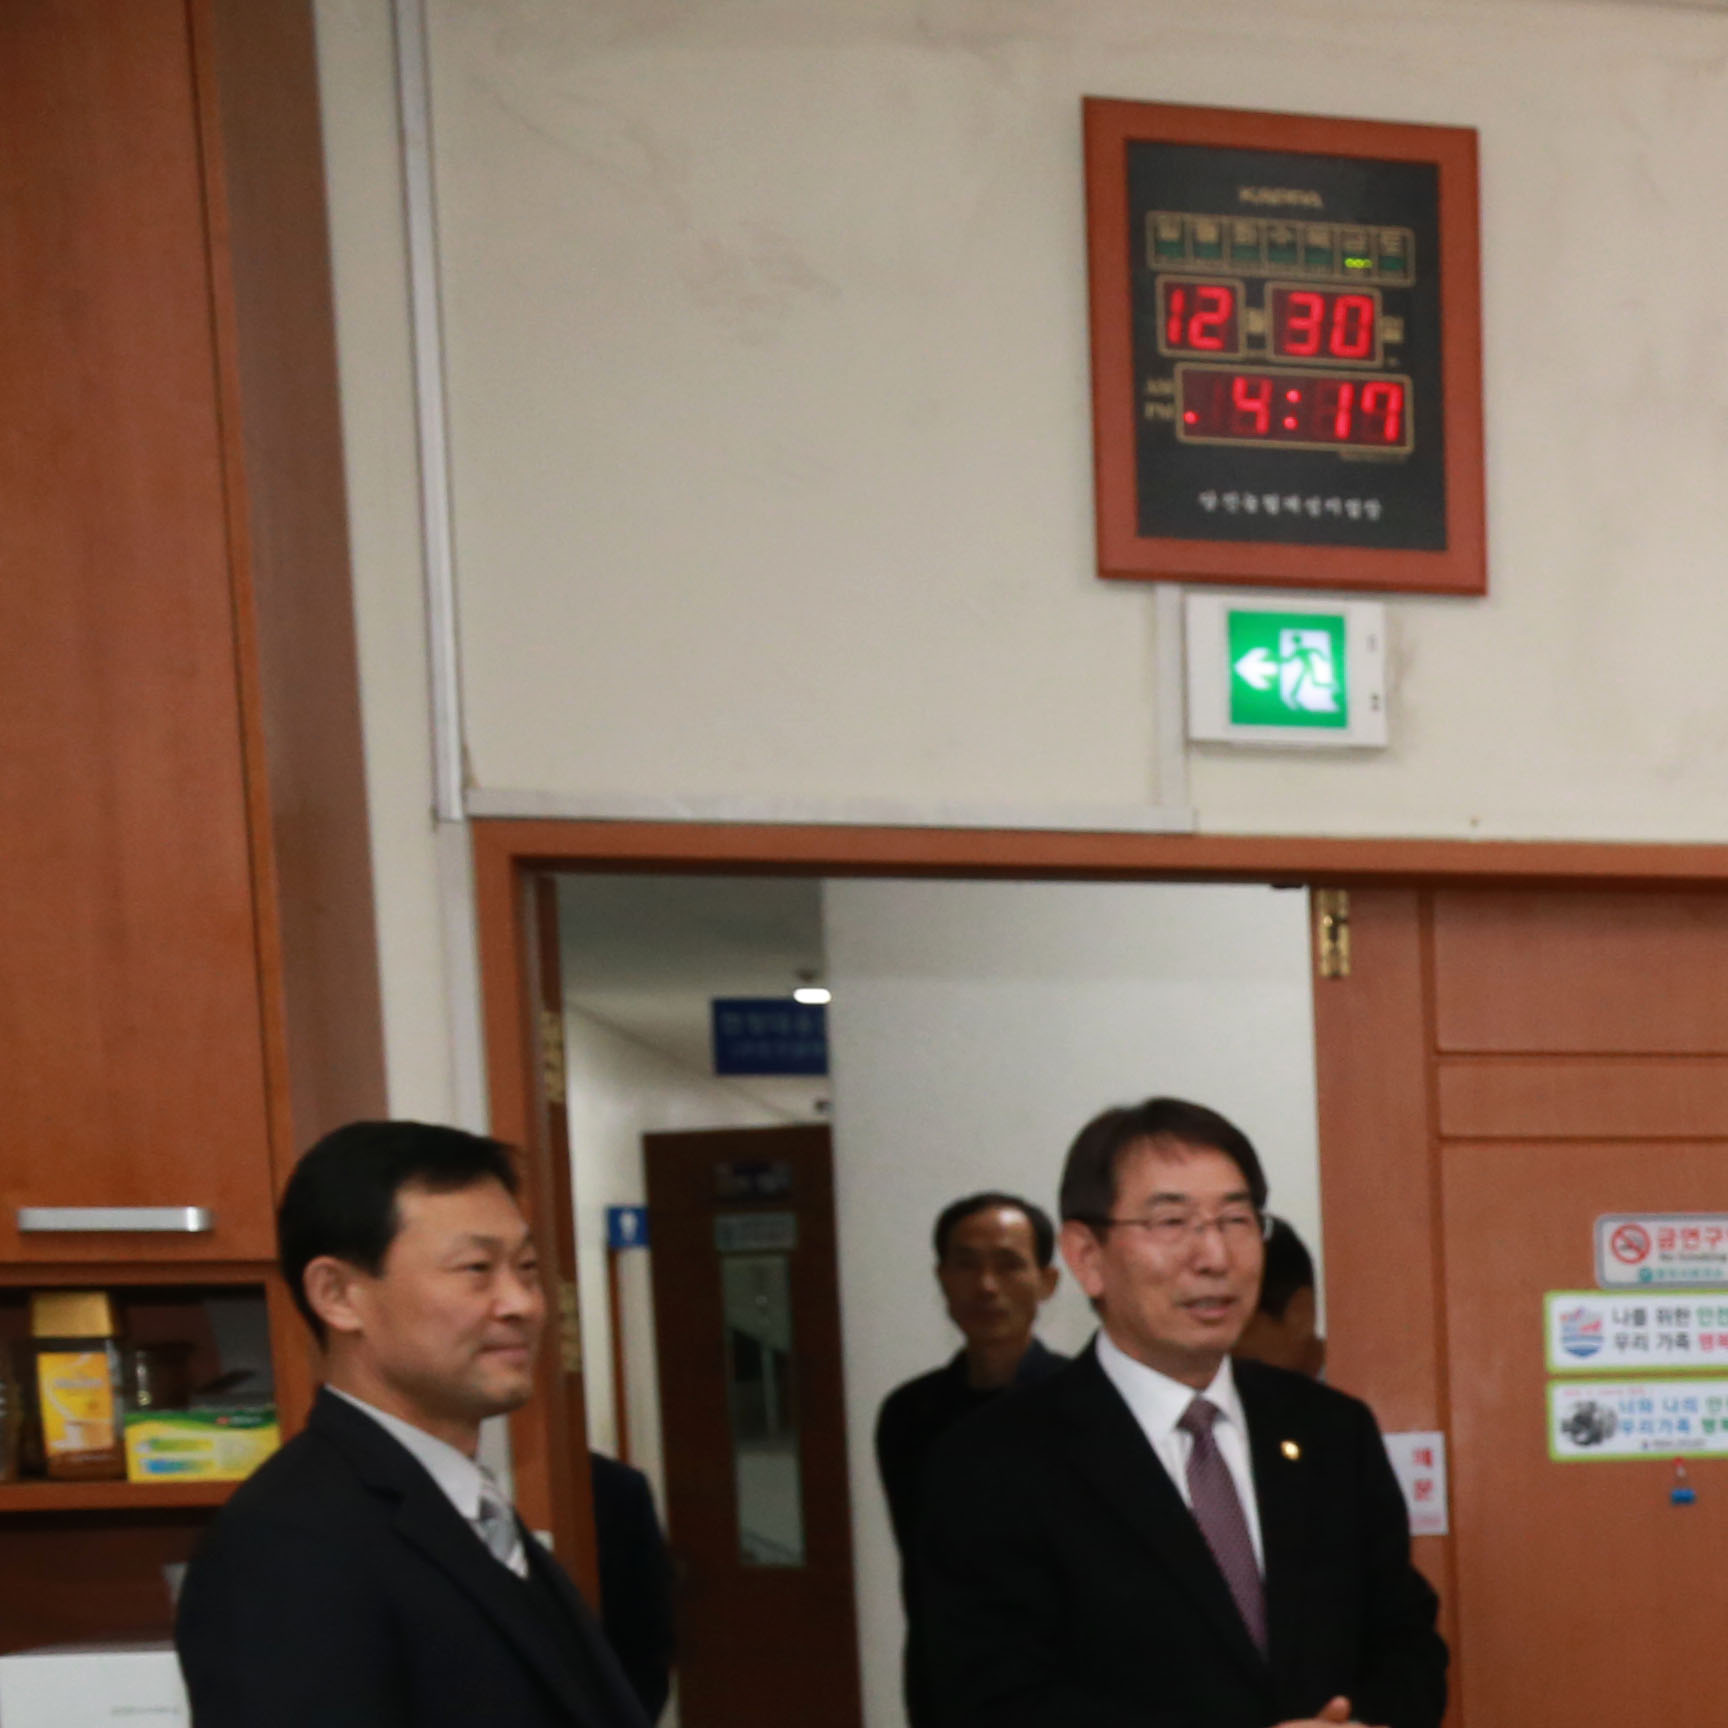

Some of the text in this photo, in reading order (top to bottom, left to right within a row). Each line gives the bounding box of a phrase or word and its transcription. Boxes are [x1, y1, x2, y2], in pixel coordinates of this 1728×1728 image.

[1167, 286, 1375, 358] 12 30
[1232, 376, 1405, 443] 4:17
[1612, 1306, 1647, 1327] 나를
[1656, 1306, 1691, 1327] 위한
[1614, 1332, 1649, 1353] 우리
